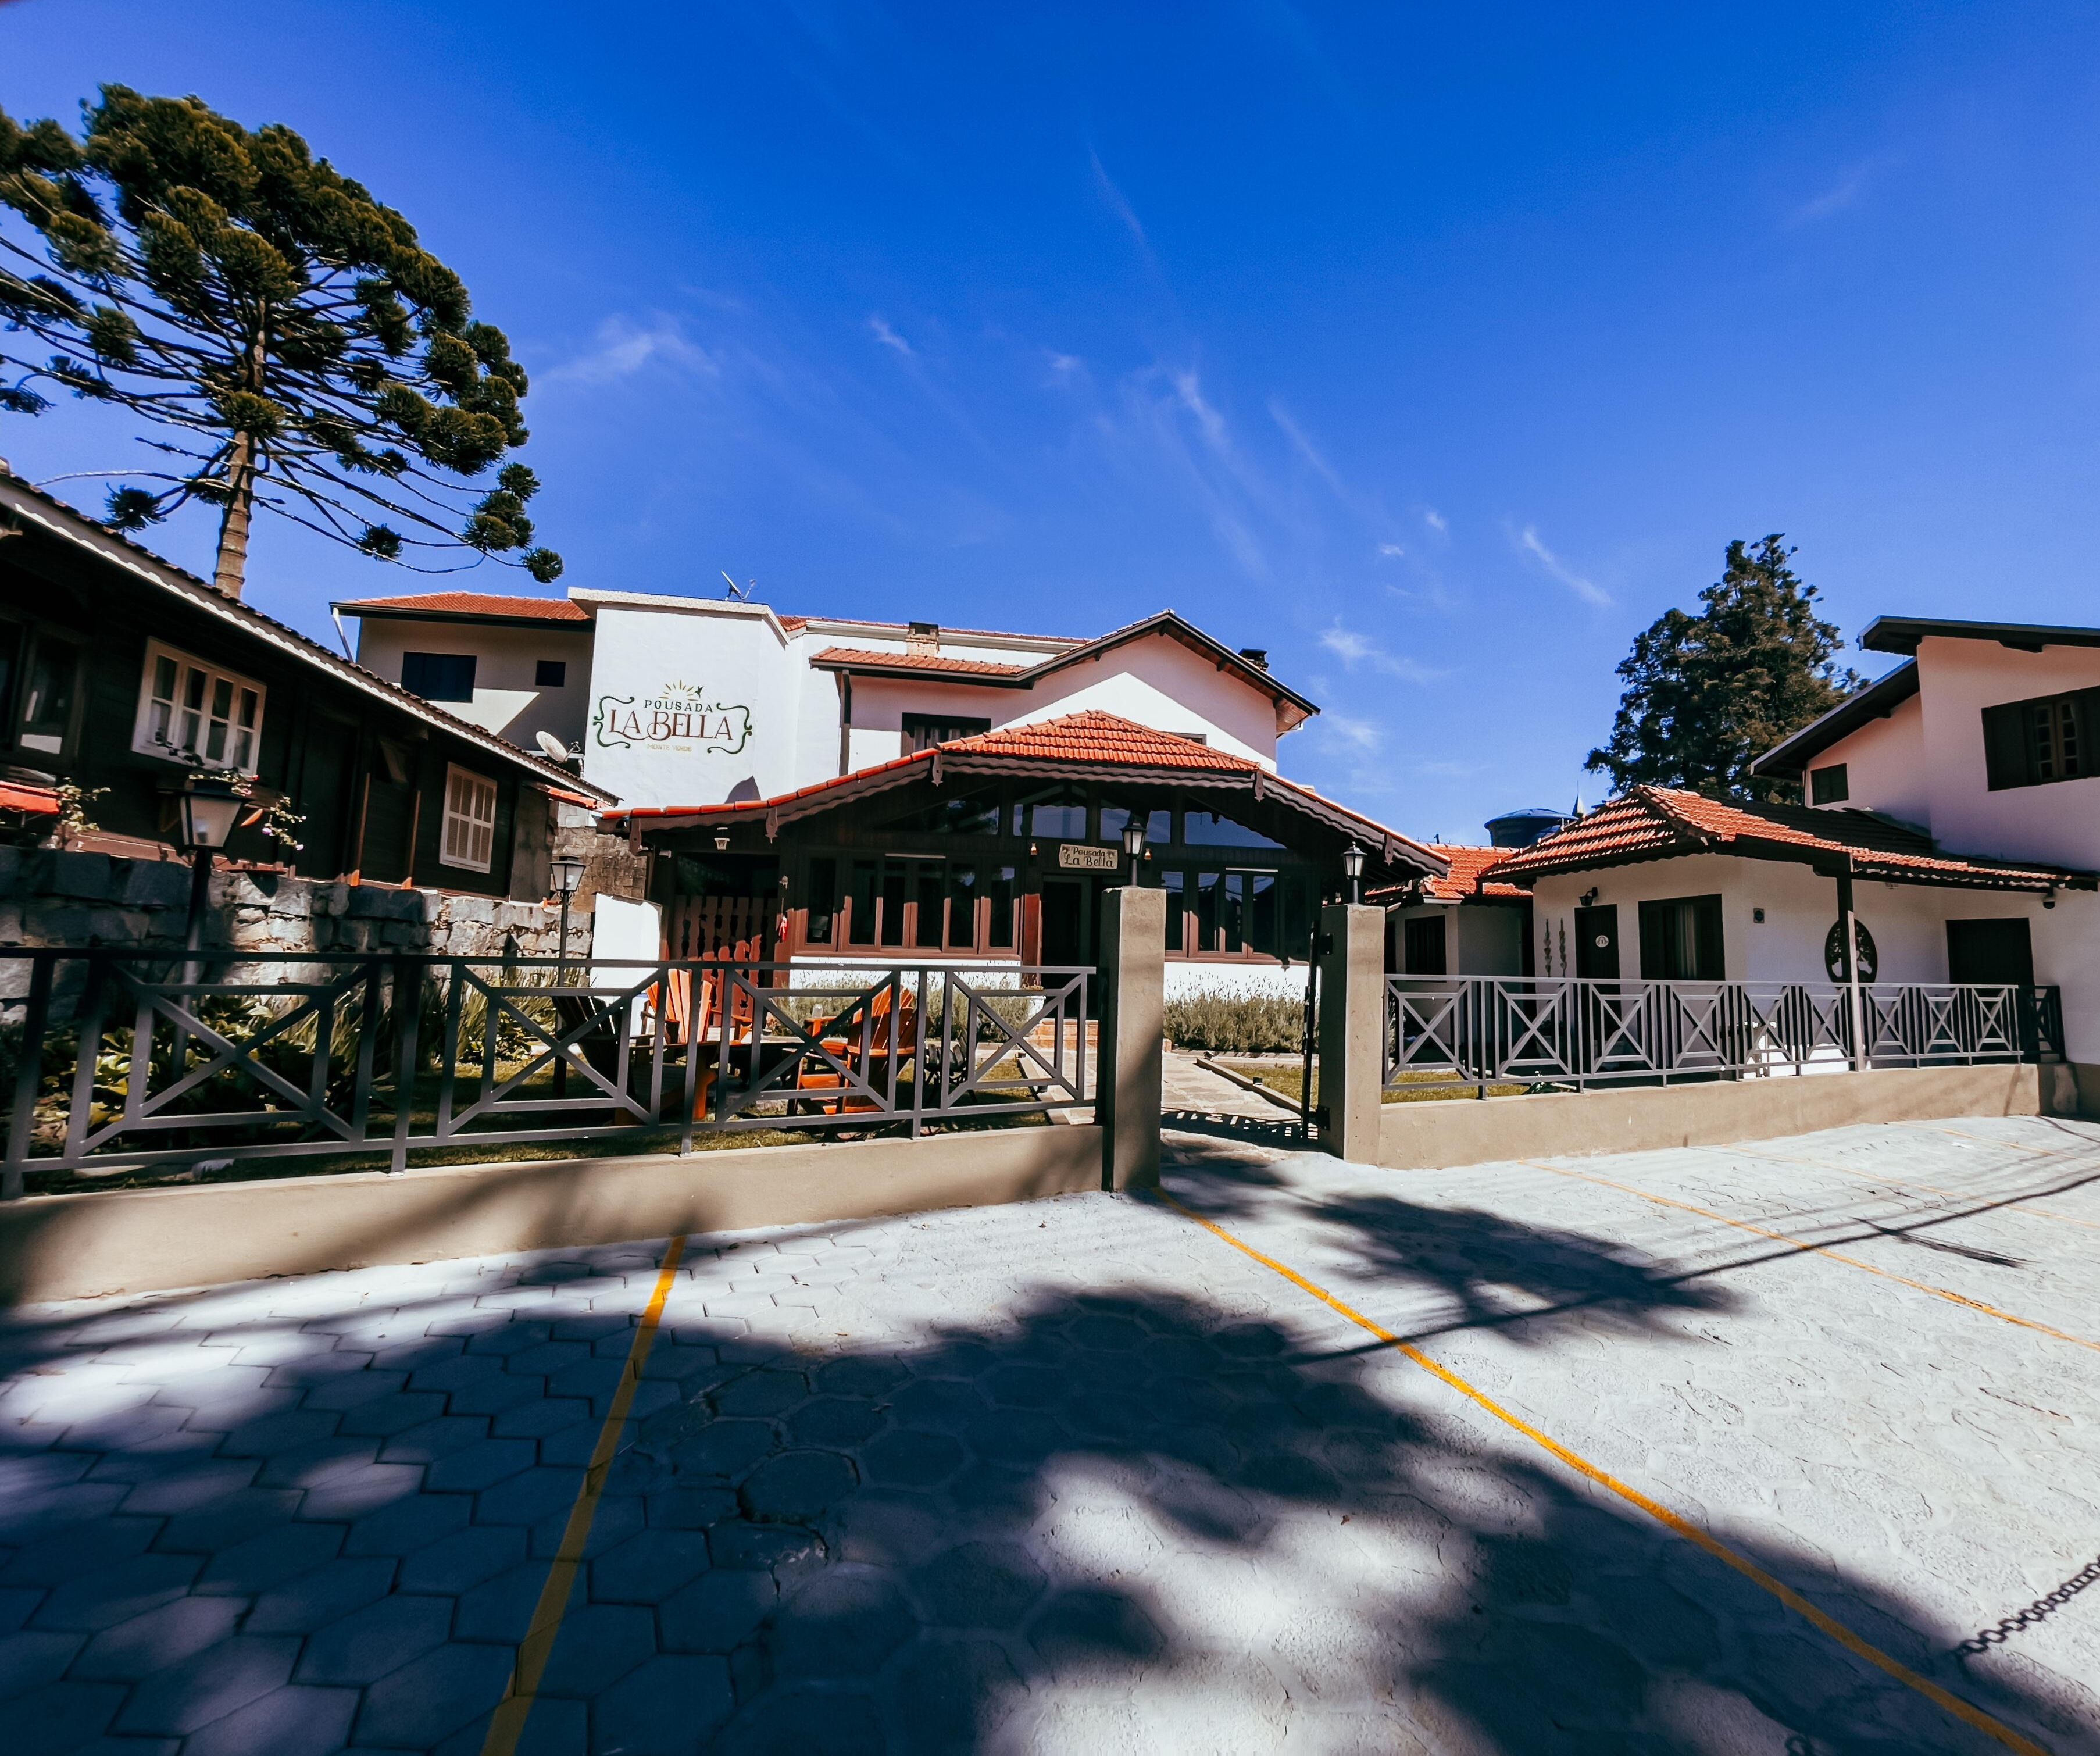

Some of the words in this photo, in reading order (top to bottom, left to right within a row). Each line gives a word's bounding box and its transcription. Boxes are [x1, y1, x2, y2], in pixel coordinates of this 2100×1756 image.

[644, 699, 713, 713] POUSADA
[609, 709, 646, 739] LA
[647, 711, 734, 741] BELLA
[1072, 847, 1105, 857] Pousada
[1064, 854, 1080, 865] La
[1084, 856, 1114, 868] Bella
